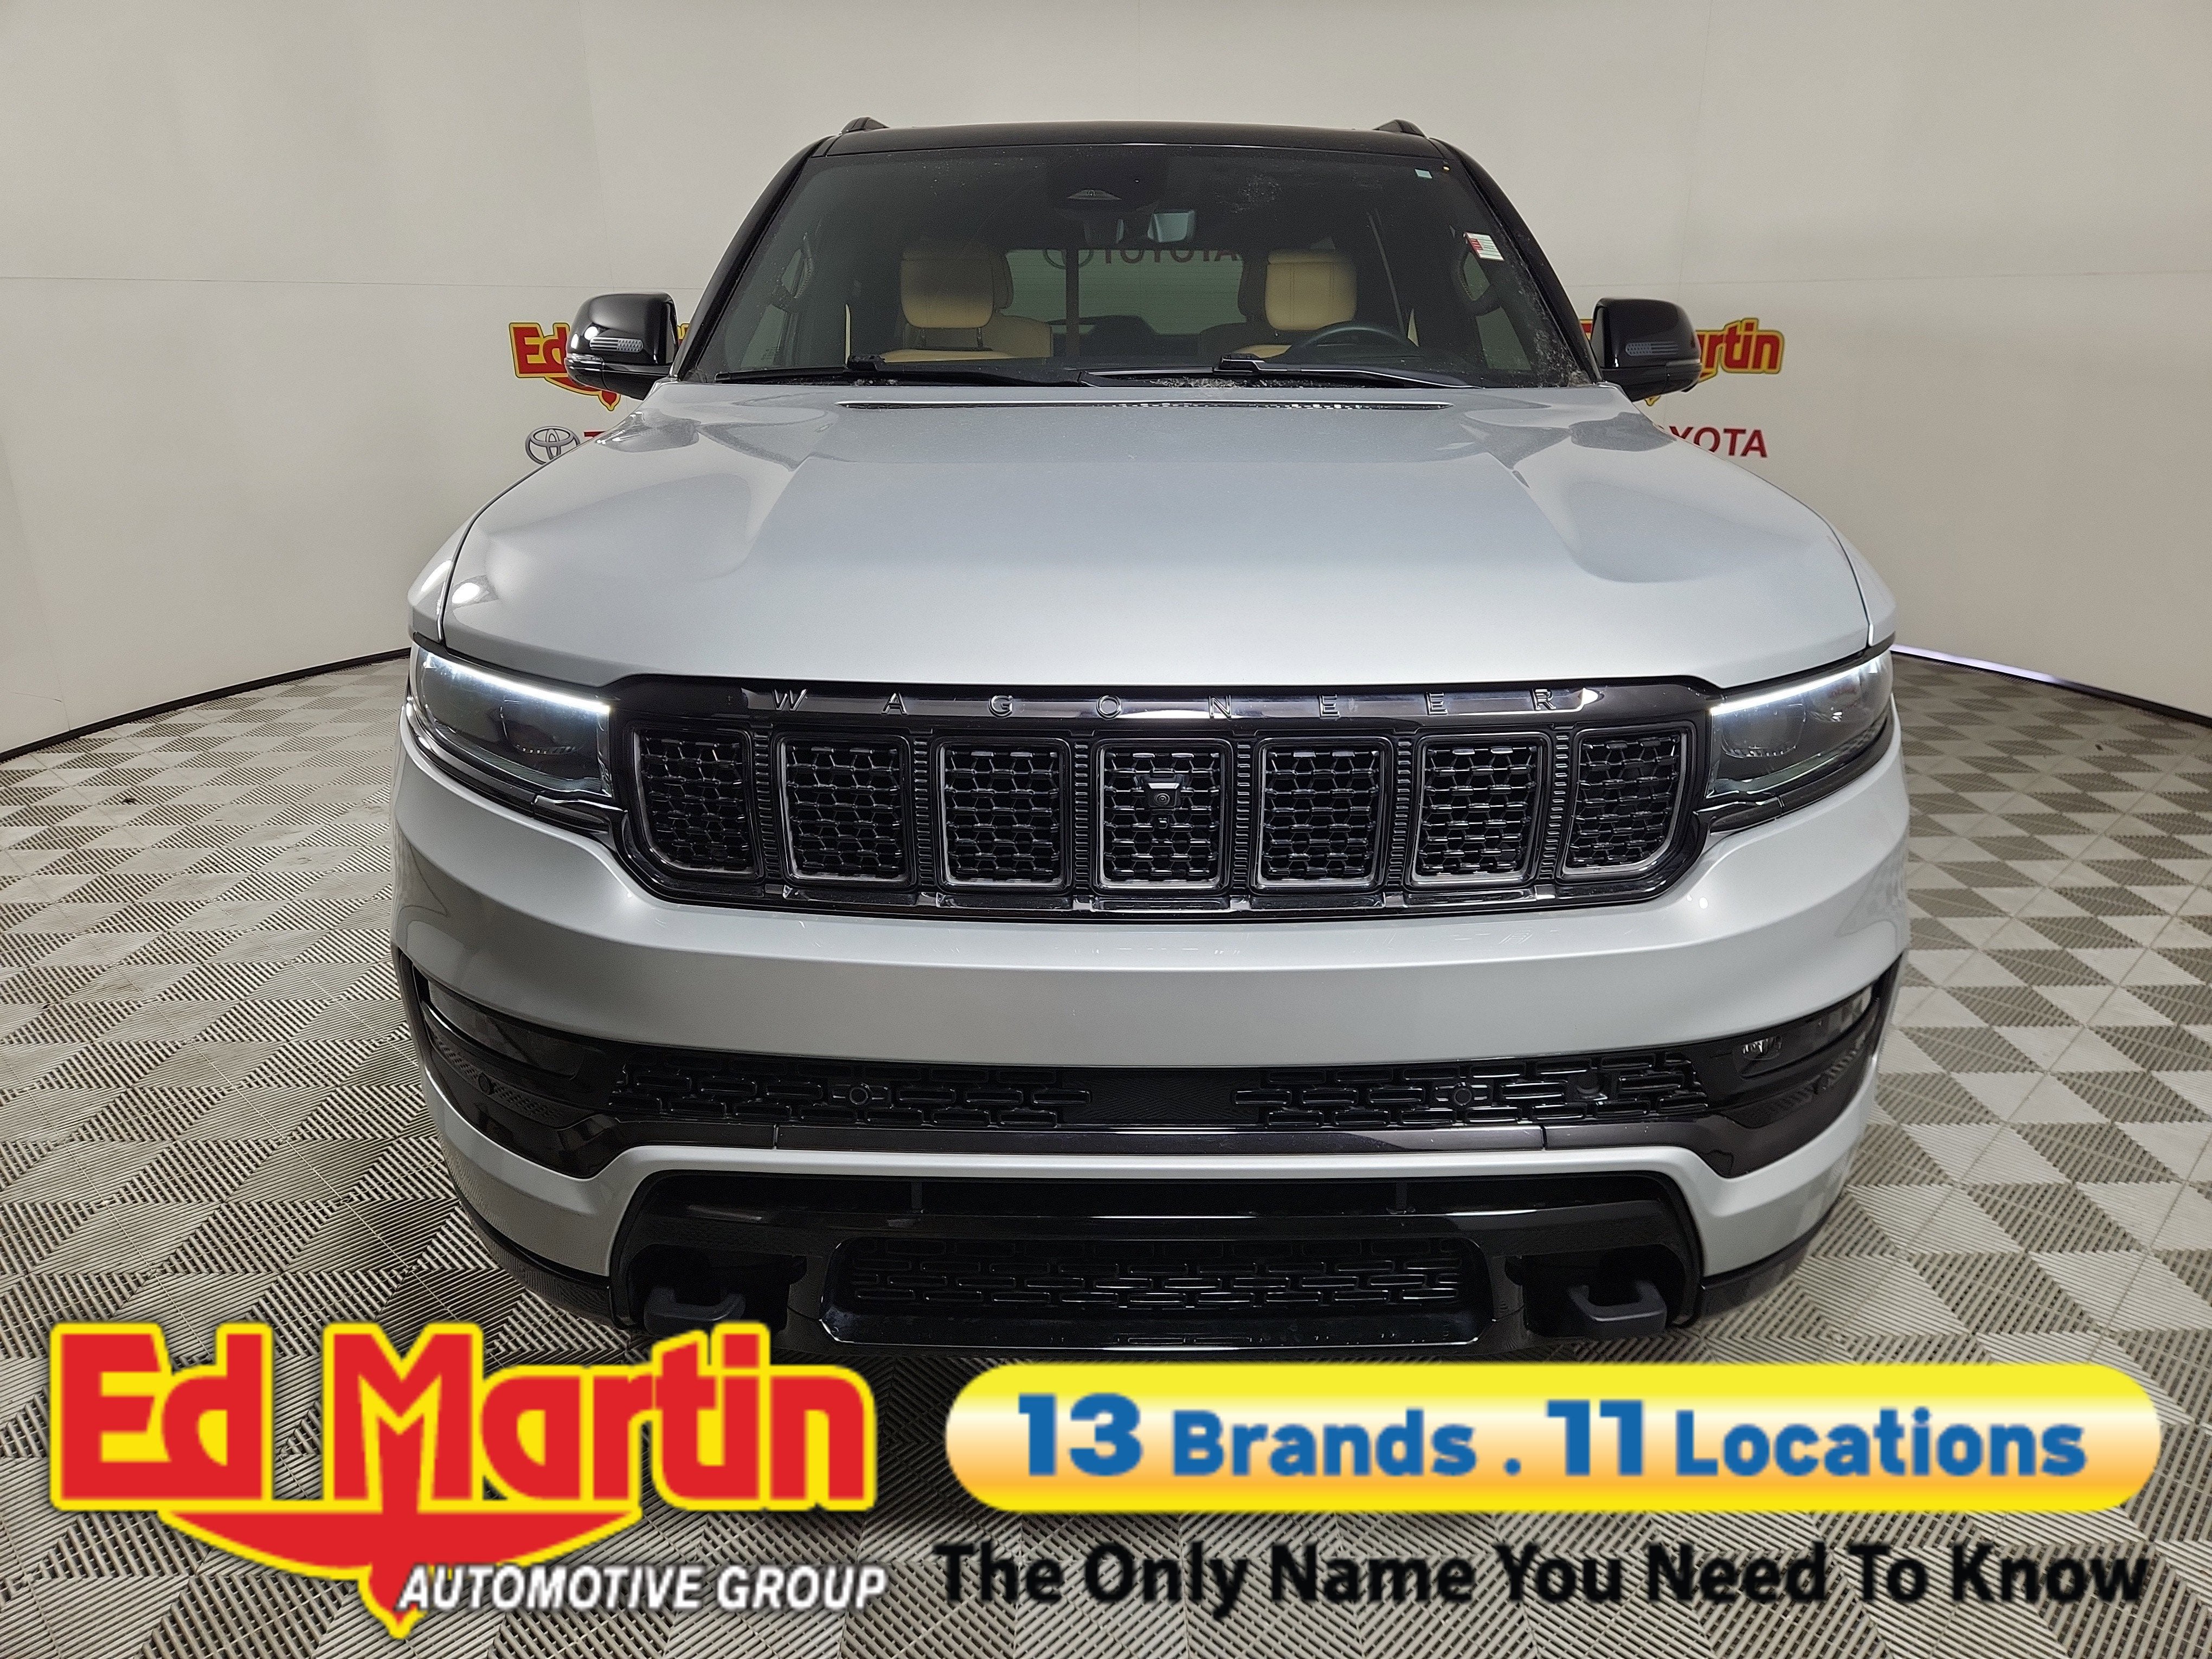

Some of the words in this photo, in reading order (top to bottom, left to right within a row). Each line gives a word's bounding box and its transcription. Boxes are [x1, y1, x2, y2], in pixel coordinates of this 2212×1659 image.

[511, 324, 569, 376] Ed
[1697, 319, 1783, 372] rtin
[1668, 425, 1768, 458] YOTA
[771, 687, 1555, 719] WAGONEER
